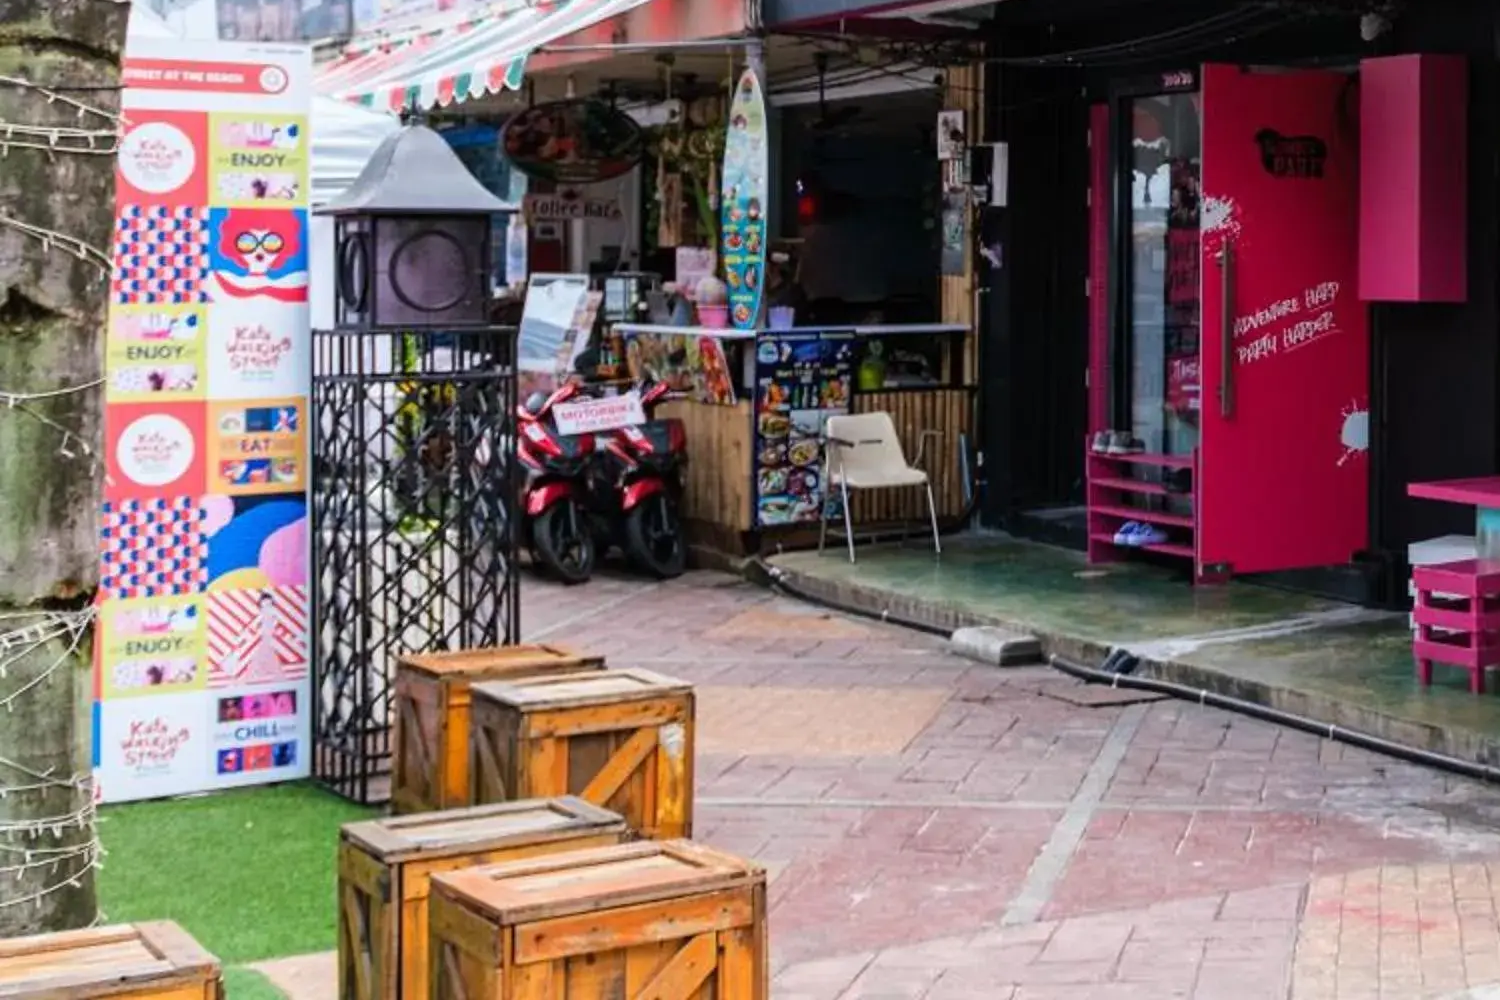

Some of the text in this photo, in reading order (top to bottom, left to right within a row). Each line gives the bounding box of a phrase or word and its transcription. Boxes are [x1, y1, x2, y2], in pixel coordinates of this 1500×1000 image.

[230, 152, 287, 168] ENJOY
[1237, 311, 1337, 365] PARTY HARDER
[126, 345, 185, 361] ENJOY
[239, 438, 273, 453] EAT
[124, 636, 184, 656] ENJOY
[233, 721, 279, 741] CHILL
